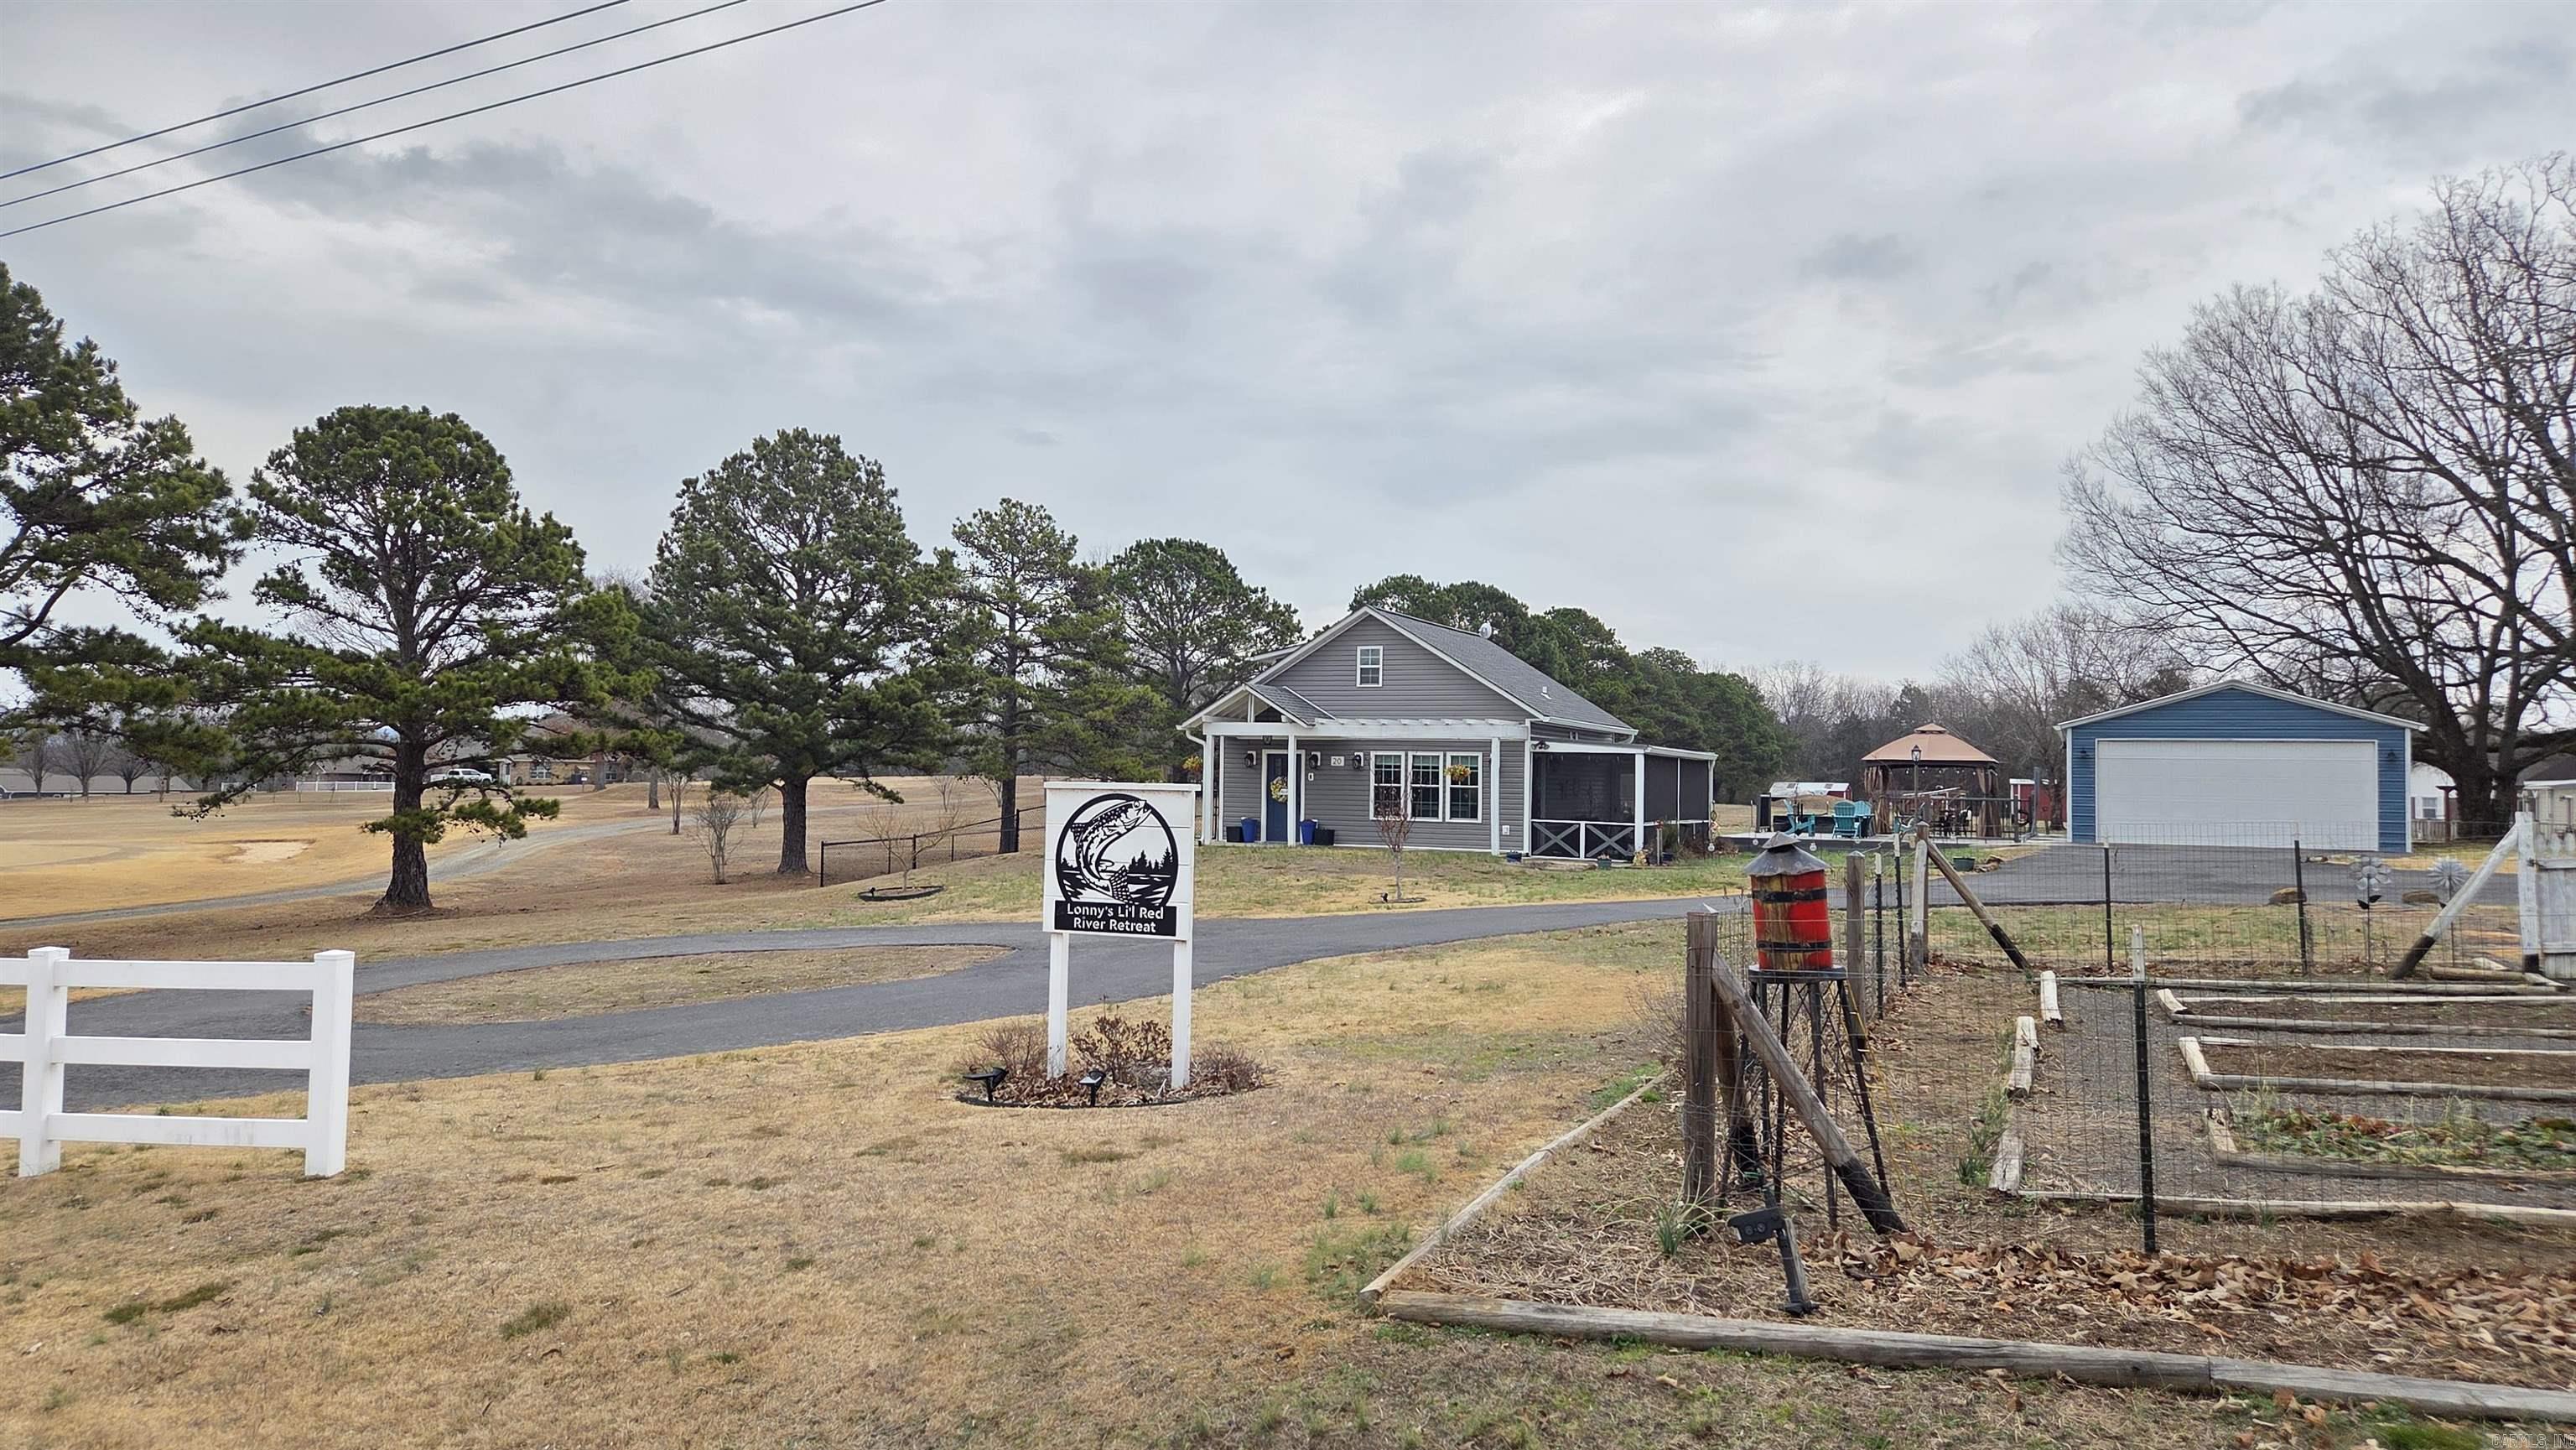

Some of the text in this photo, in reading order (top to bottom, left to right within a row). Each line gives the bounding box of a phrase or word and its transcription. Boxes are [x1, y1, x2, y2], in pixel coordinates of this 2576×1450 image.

[1067, 902, 1164, 920] Lonny's Li'l Red
[1073, 916, 1156, 933] River Retreat
